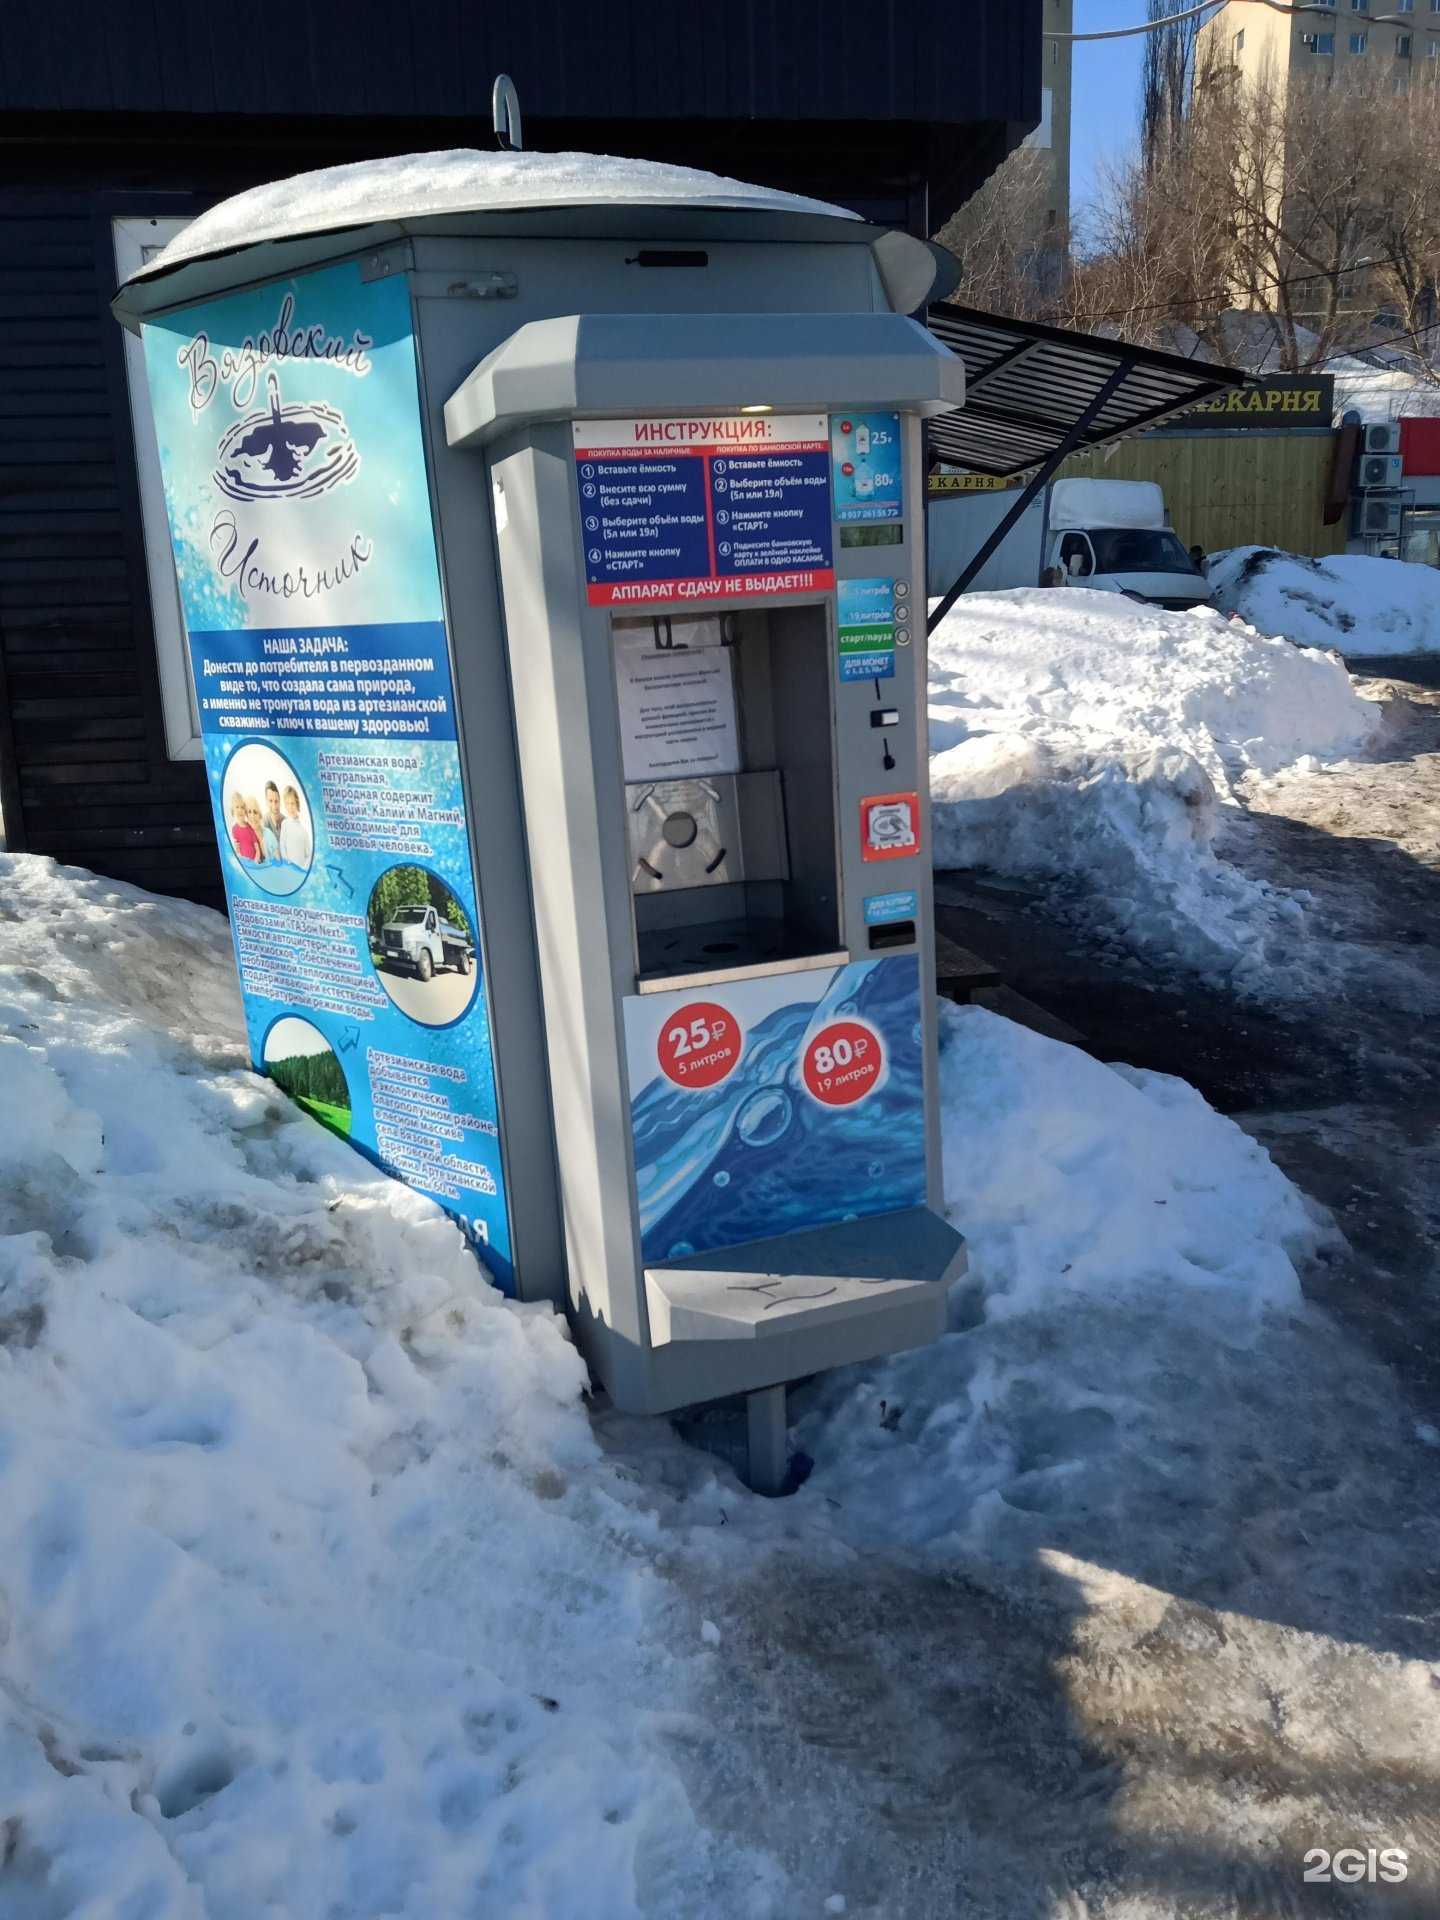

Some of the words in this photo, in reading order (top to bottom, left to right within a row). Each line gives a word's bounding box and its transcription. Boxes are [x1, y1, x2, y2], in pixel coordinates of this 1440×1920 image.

[179, 296, 370, 409] Вязовский
[1192, 389, 1322, 412] ЕКАРНЯ
[634, 420, 772, 442] ИНСТРУКЦИЯ:
[588, 449, 620, 457] ПОКУПКА
[622, 448, 642, 456] ВОДЫ
[644, 448, 653, 456] ЗА
[716, 445, 749, 453] ПОКУПКА
[749, 445, 759, 453] ПО
[759, 444, 801, 452] БАНКОВСКОЙ
[598, 465, 637, 475] Вставьте
[639, 464, 676, 473] ёмкость
[728, 460, 766, 470] Вставьте
[767, 458, 803, 468] ёмкость
[599, 484, 636, 494] Внесите
[638, 485, 656, 493] всю
[657, 483, 687, 493] сумму
[729, 478, 773, 489] Выберите
[774, 476, 803, 486] объём
[803, 477, 827, 486] воды
[600, 496, 620, 508] (без
[621, 495, 652, 507] сдачи)
[730, 490, 745, 502] (5л
[746, 491, 763, 499] или
[764, 487, 784, 499] 19л)
[602, 517, 647, 528] Выберите
[649, 514, 679, 525] объём
[680, 515, 705, 524] воды
[731, 511, 772, 520] Нажмите
[773, 509, 804, 519] кнопку
[603, 528, 618, 540] (5л
[619, 529, 638, 538] или
[639, 527, 659, 539] 19л)
[732, 521, 769, 531] «СТАРТ»
[604, 550, 647, 559] Нажмите
[648, 547, 681, 557] кнопку
[734, 542, 770, 551] Поднесите
[771, 539, 813, 548] банковскую
[210, 510, 372, 599] Источник
[734, 550, 753, 559] карту
[734, 558, 763, 567] ОПЛАТИ
[770, 556, 791, 566] ОДНО
[792, 554, 824, 563] КАСАНИЕ
[606, 560, 644, 570] «СТАРТ»
[611, 584, 674, 600] АППАРАТ
[677, 580, 721, 597] СДАЧУ
[725, 579, 743, 592] НЕ
[745, 573, 813, 592] ВЫДАЕТ!!!
[263, 638, 297, 654] НАША
[299, 636, 349, 656] ЗАДАЧА:
[203, 658, 244, 676] Донести
[245, 661, 259, 676] до
[259, 658, 329, 675] потребителя
[330, 661, 338, 672] в
[339, 658, 434, 676] первозданном
[220, 681, 245, 693] виде
[246, 681, 261, 694] то,
[262, 681, 280, 692] что
[281, 680, 325, 694] создала
[326, 681, 355, 692] сама
[356, 680, 416, 695] природа,
[202, 700, 209, 709] а
[210, 698, 247, 710] именно
[248, 699, 261, 710] не
[261, 699, 311, 714] тронутая
[313, 699, 341, 714] вода
[342, 700, 356, 711] из
[358, 696, 447, 715] артезианской
[218, 717, 270, 728] скважины
[276, 718, 305, 729] ключ
[306, 719, 314, 729] к
[314, 719, 359, 734] вашему
[361, 717, 430, 735] здоровью!
[318, 752, 388, 768] Артезианская
[391, 758, 418, 770] вода
[320, 770, 389, 785] натуральная,
[323, 787, 378, 800] природная
[380, 791, 433, 805] содержит
[325, 802, 370, 818] Кальций,
[372, 804, 406, 818] Калий
[407, 810, 415, 819] и
[417, 807, 465, 824] Магний,
[327, 820, 398, 835] необходимые
[399, 826, 420, 837] для
[330, 835, 377, 850] здоровья
[378, 841, 433, 855] человека.
[233, 896, 269, 911] Доставка
[270, 904, 292, 915] воды
[292, 907, 364, 926] осуществляется
[235, 912, 287, 927] водовозами
[239, 940, 257, 951] баки
[331, 943, 348, 954] как
[241, 954, 297, 973] необходимой
[313, 997, 343, 1009] режим
[368, 1048, 439, 1074] Артезианская
[440, 1067, 467, 1080] вода
[678, 1063, 688, 1075] 5
[689, 1047, 732, 1073] литров
[369, 1067, 429, 1087] добывается
[817, 1077, 833, 1093] 19
[834, 1063, 875, 1087] литров
[378, 1082, 449, 1106] экологически
[373, 1092, 450, 1120] благополучном
[453, 1114, 498, 1135] районе,
[381, 1112, 417, 1128] лесном
[420, 1121, 464, 1140] массиве
[399, 1128, 441, 1149] Вязовка
[379, 1136, 441, 1162] Саратовской
[421, 1161, 497, 1193] Артезианской
